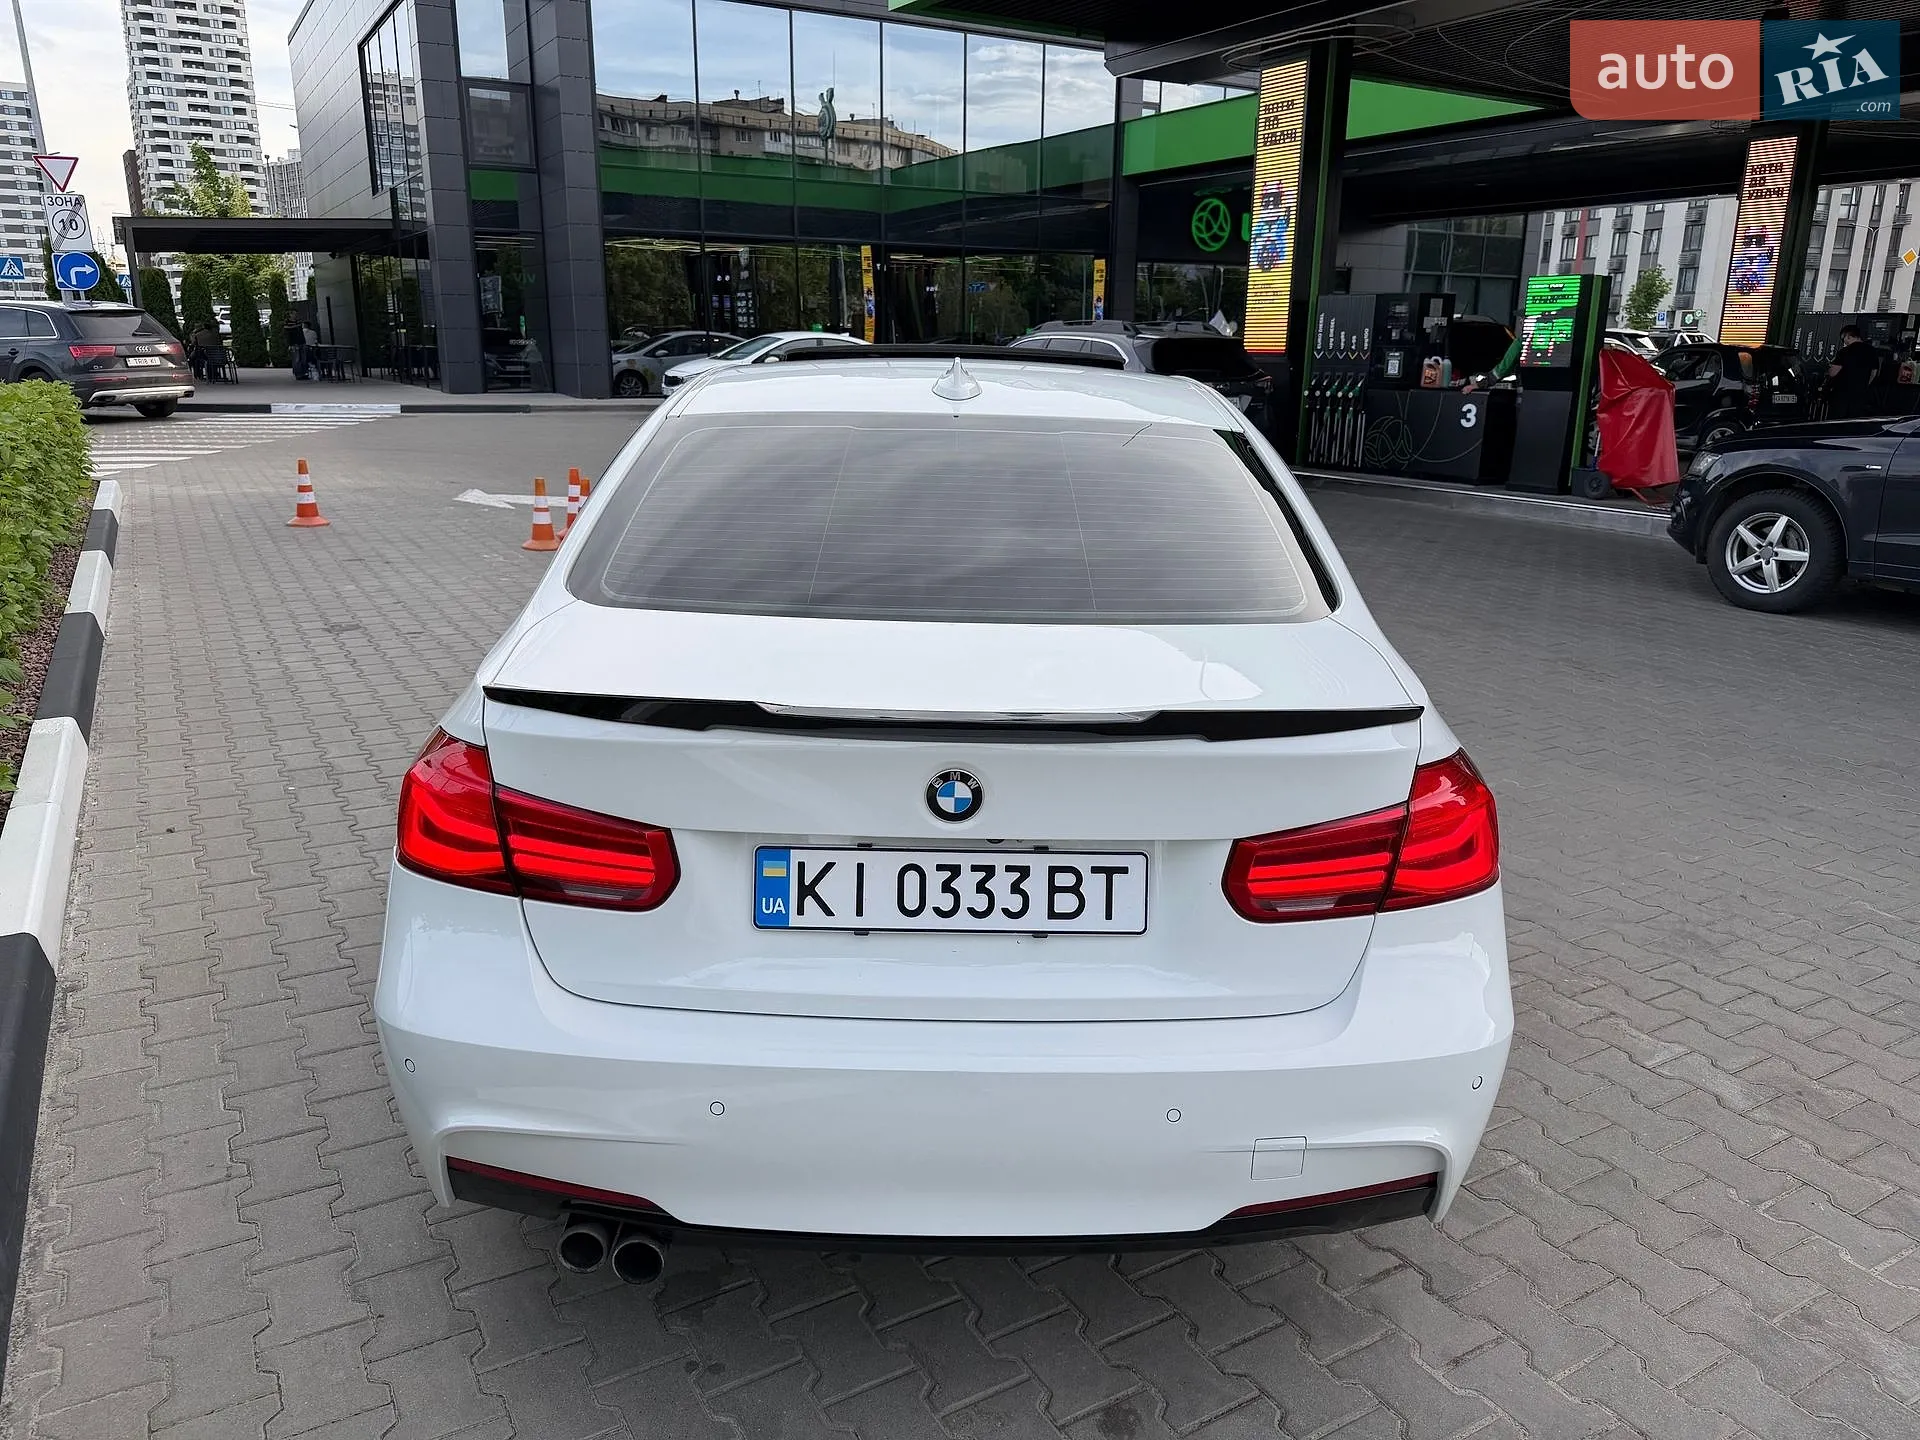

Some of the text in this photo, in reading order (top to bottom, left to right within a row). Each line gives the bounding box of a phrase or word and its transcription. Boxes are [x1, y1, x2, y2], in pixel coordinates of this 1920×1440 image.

[46, 196, 83, 207] ЗОНА
[58, 218, 79, 231] 10
[1460, 403, 1478, 428] 3
[931, 771, 979, 790] BMW
[796, 861, 1129, 921] KI 0333 BT
[762, 897, 786, 914] UA
